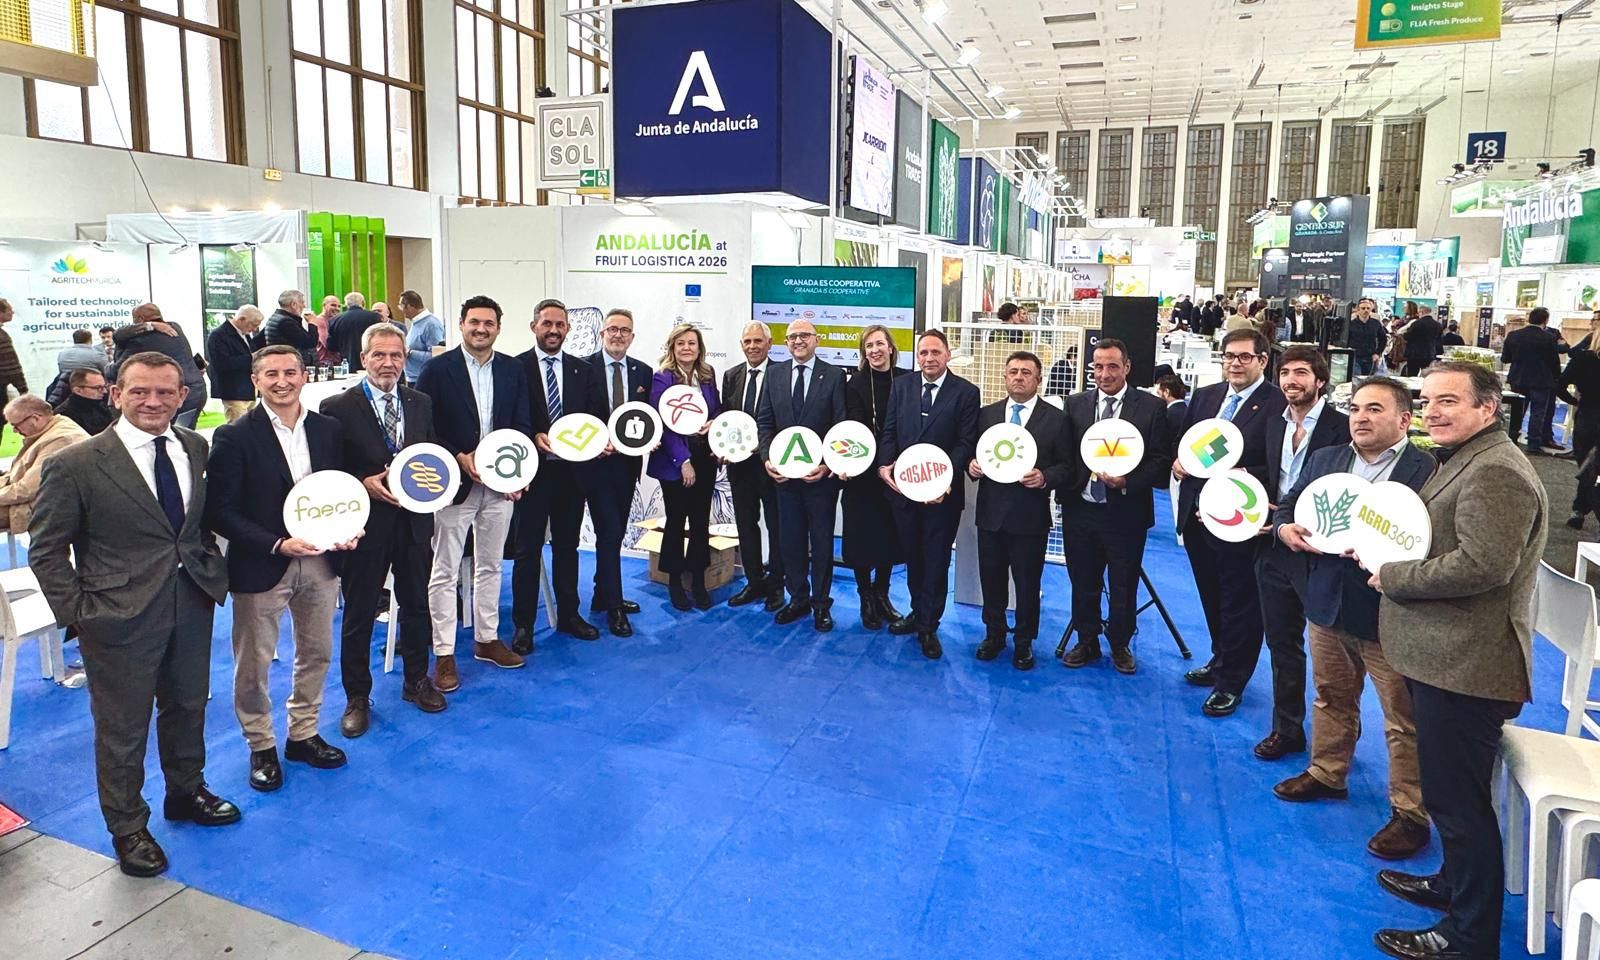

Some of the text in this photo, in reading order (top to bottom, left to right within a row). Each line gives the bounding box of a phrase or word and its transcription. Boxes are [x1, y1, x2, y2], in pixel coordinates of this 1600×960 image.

[1411, 1, 1464, 11] Insights Stage
[1428, 18, 1450, 26] Fresh
[1451, 16, 1484, 24] Produce
[549, 116, 594, 138] CLA
[635, 113, 759, 137] Junta de Andalucía
[550, 145, 595, 165] SOL
[1473, 139, 1499, 158] 18
[1502, 184, 1584, 230] Andalucía
[1327, 220, 1345, 229] SUR
[595, 229, 727, 251] ANDALUCÍA at
[595, 255, 727, 267] FRUIT LOGISTICA 2026
[783, 279, 818, 287] GRANADA
[828, 280, 881, 288] COOPERATIVA
[28, 297, 142, 307] Tailored technology
[45, 309, 130, 319] for sustainable
[22, 321, 90, 333] agriculture
[899, 461, 948, 484] COSAFRA
[294, 495, 361, 522] faeca
